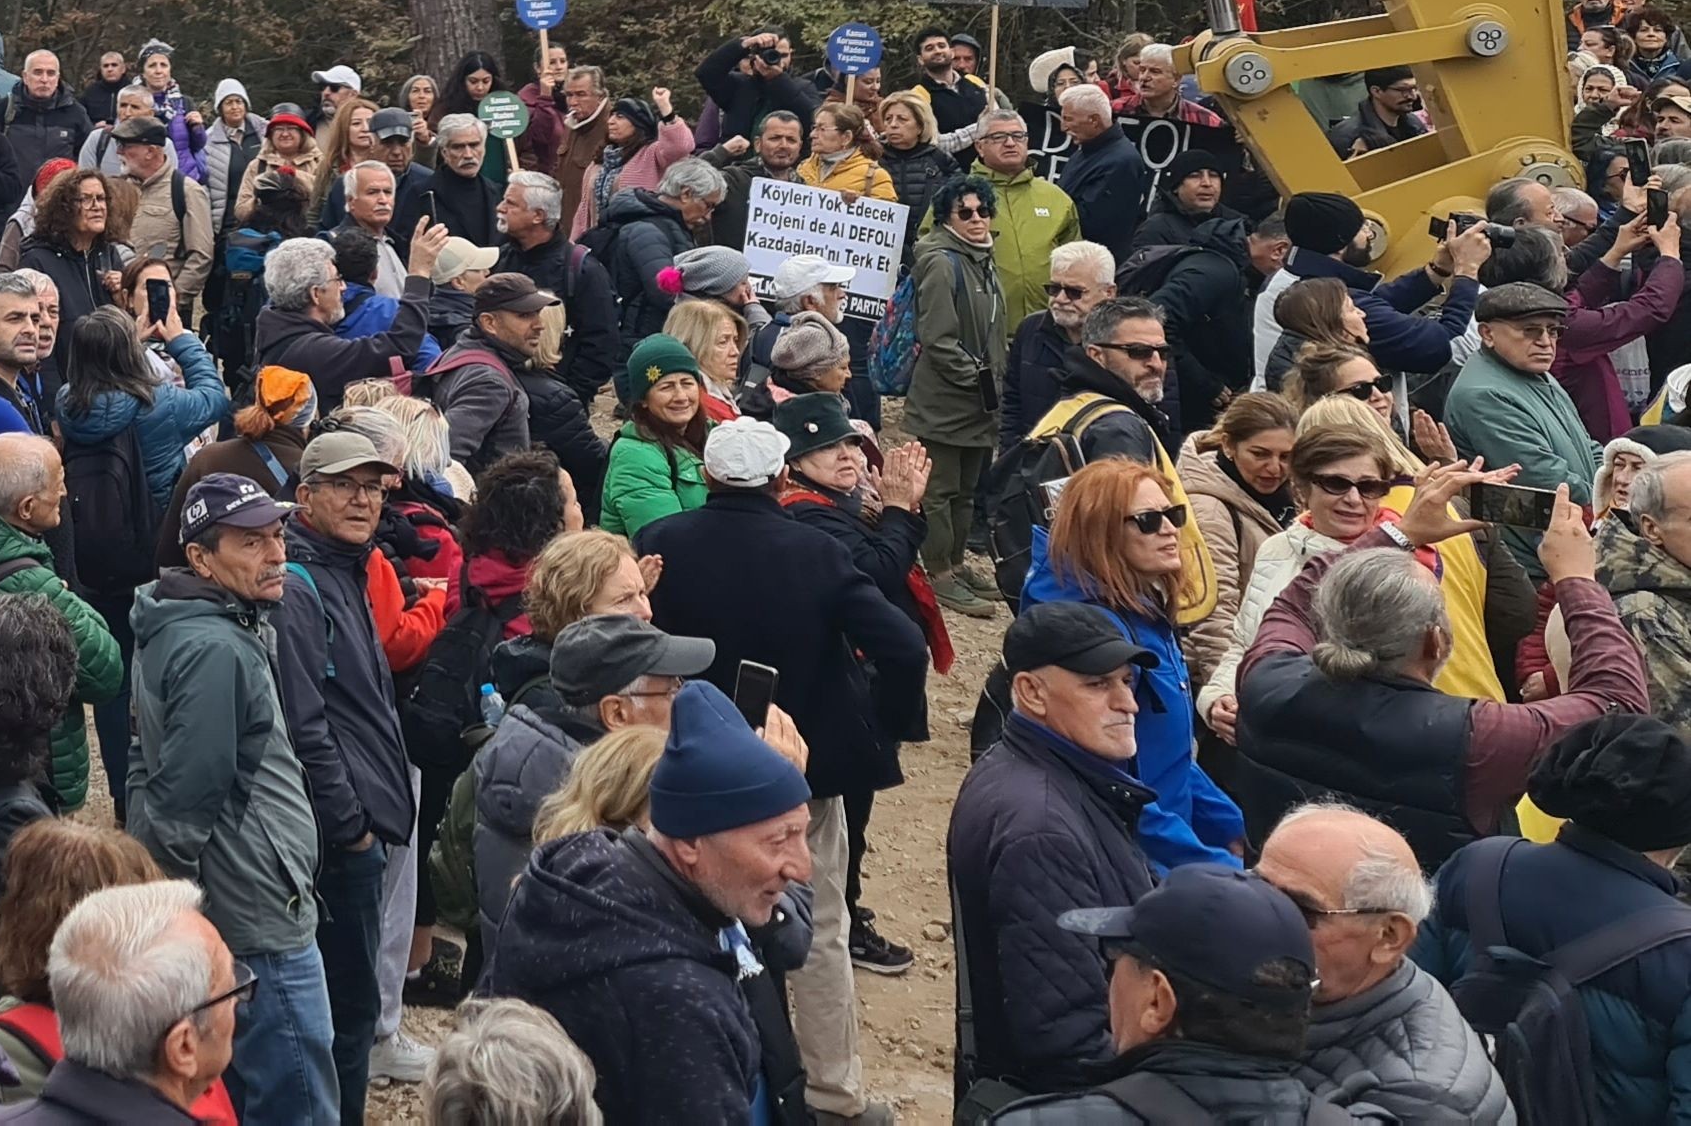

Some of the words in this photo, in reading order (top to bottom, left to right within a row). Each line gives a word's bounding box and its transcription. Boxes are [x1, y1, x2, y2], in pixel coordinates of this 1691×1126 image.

[760, 183, 813, 207] Köyleri
[818, 195, 842, 213] Yok
[846, 202, 895, 224] Edecek
[753, 207, 806, 232] Projeni
[809, 220, 827, 235] de
[830, 224, 845, 238] Al
[849, 227, 896, 249] DEFOL!
[845, 249, 874, 269] Terk
[876, 255, 891, 273] Et
